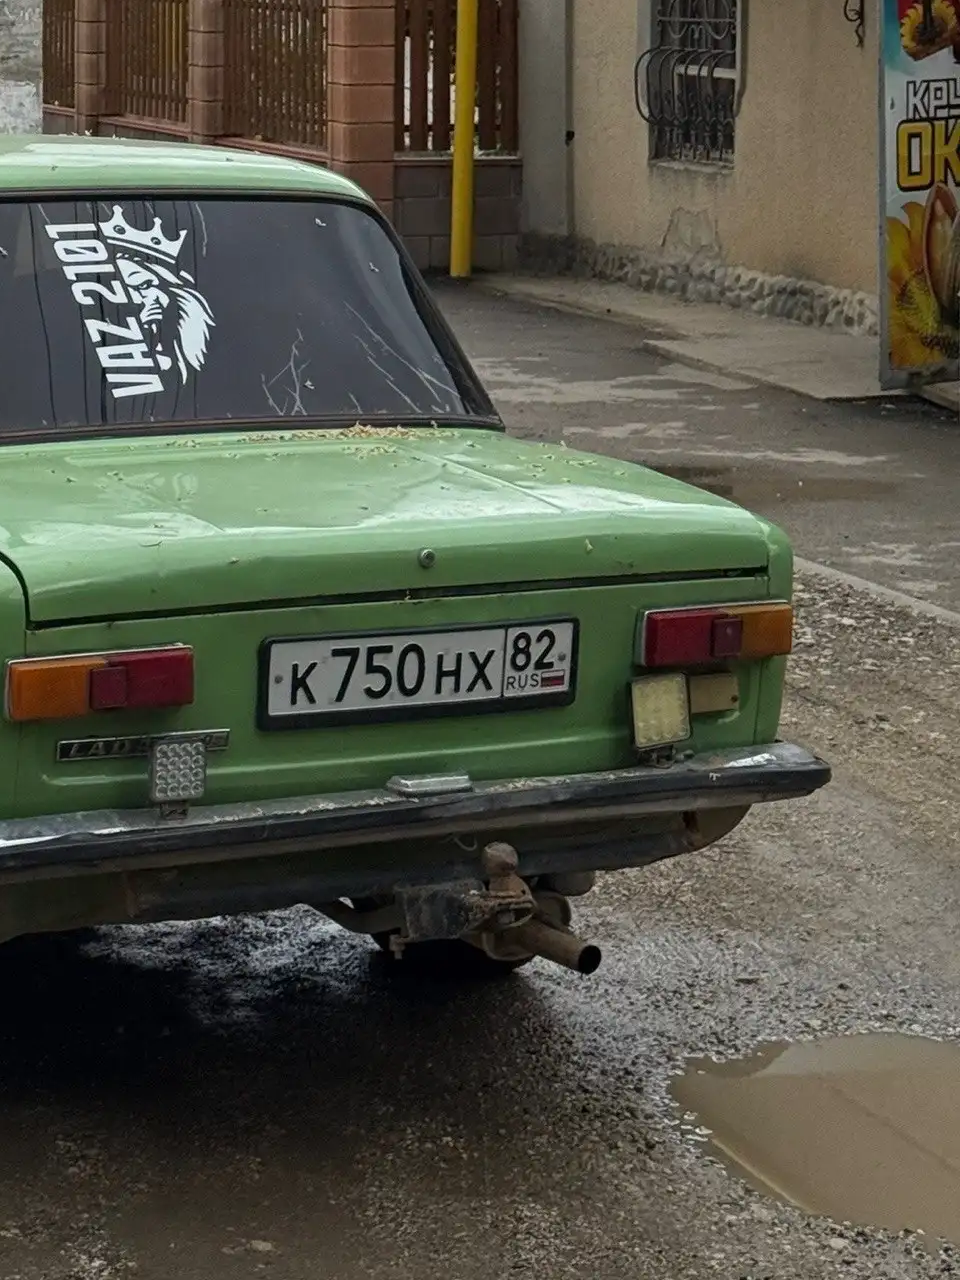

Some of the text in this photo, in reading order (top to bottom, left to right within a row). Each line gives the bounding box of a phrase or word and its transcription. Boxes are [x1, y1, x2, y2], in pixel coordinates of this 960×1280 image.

[45, 223, 165, 399] VAZ 2101
[510, 628, 557, 672] 82
[506, 673, 539, 692] RUS
